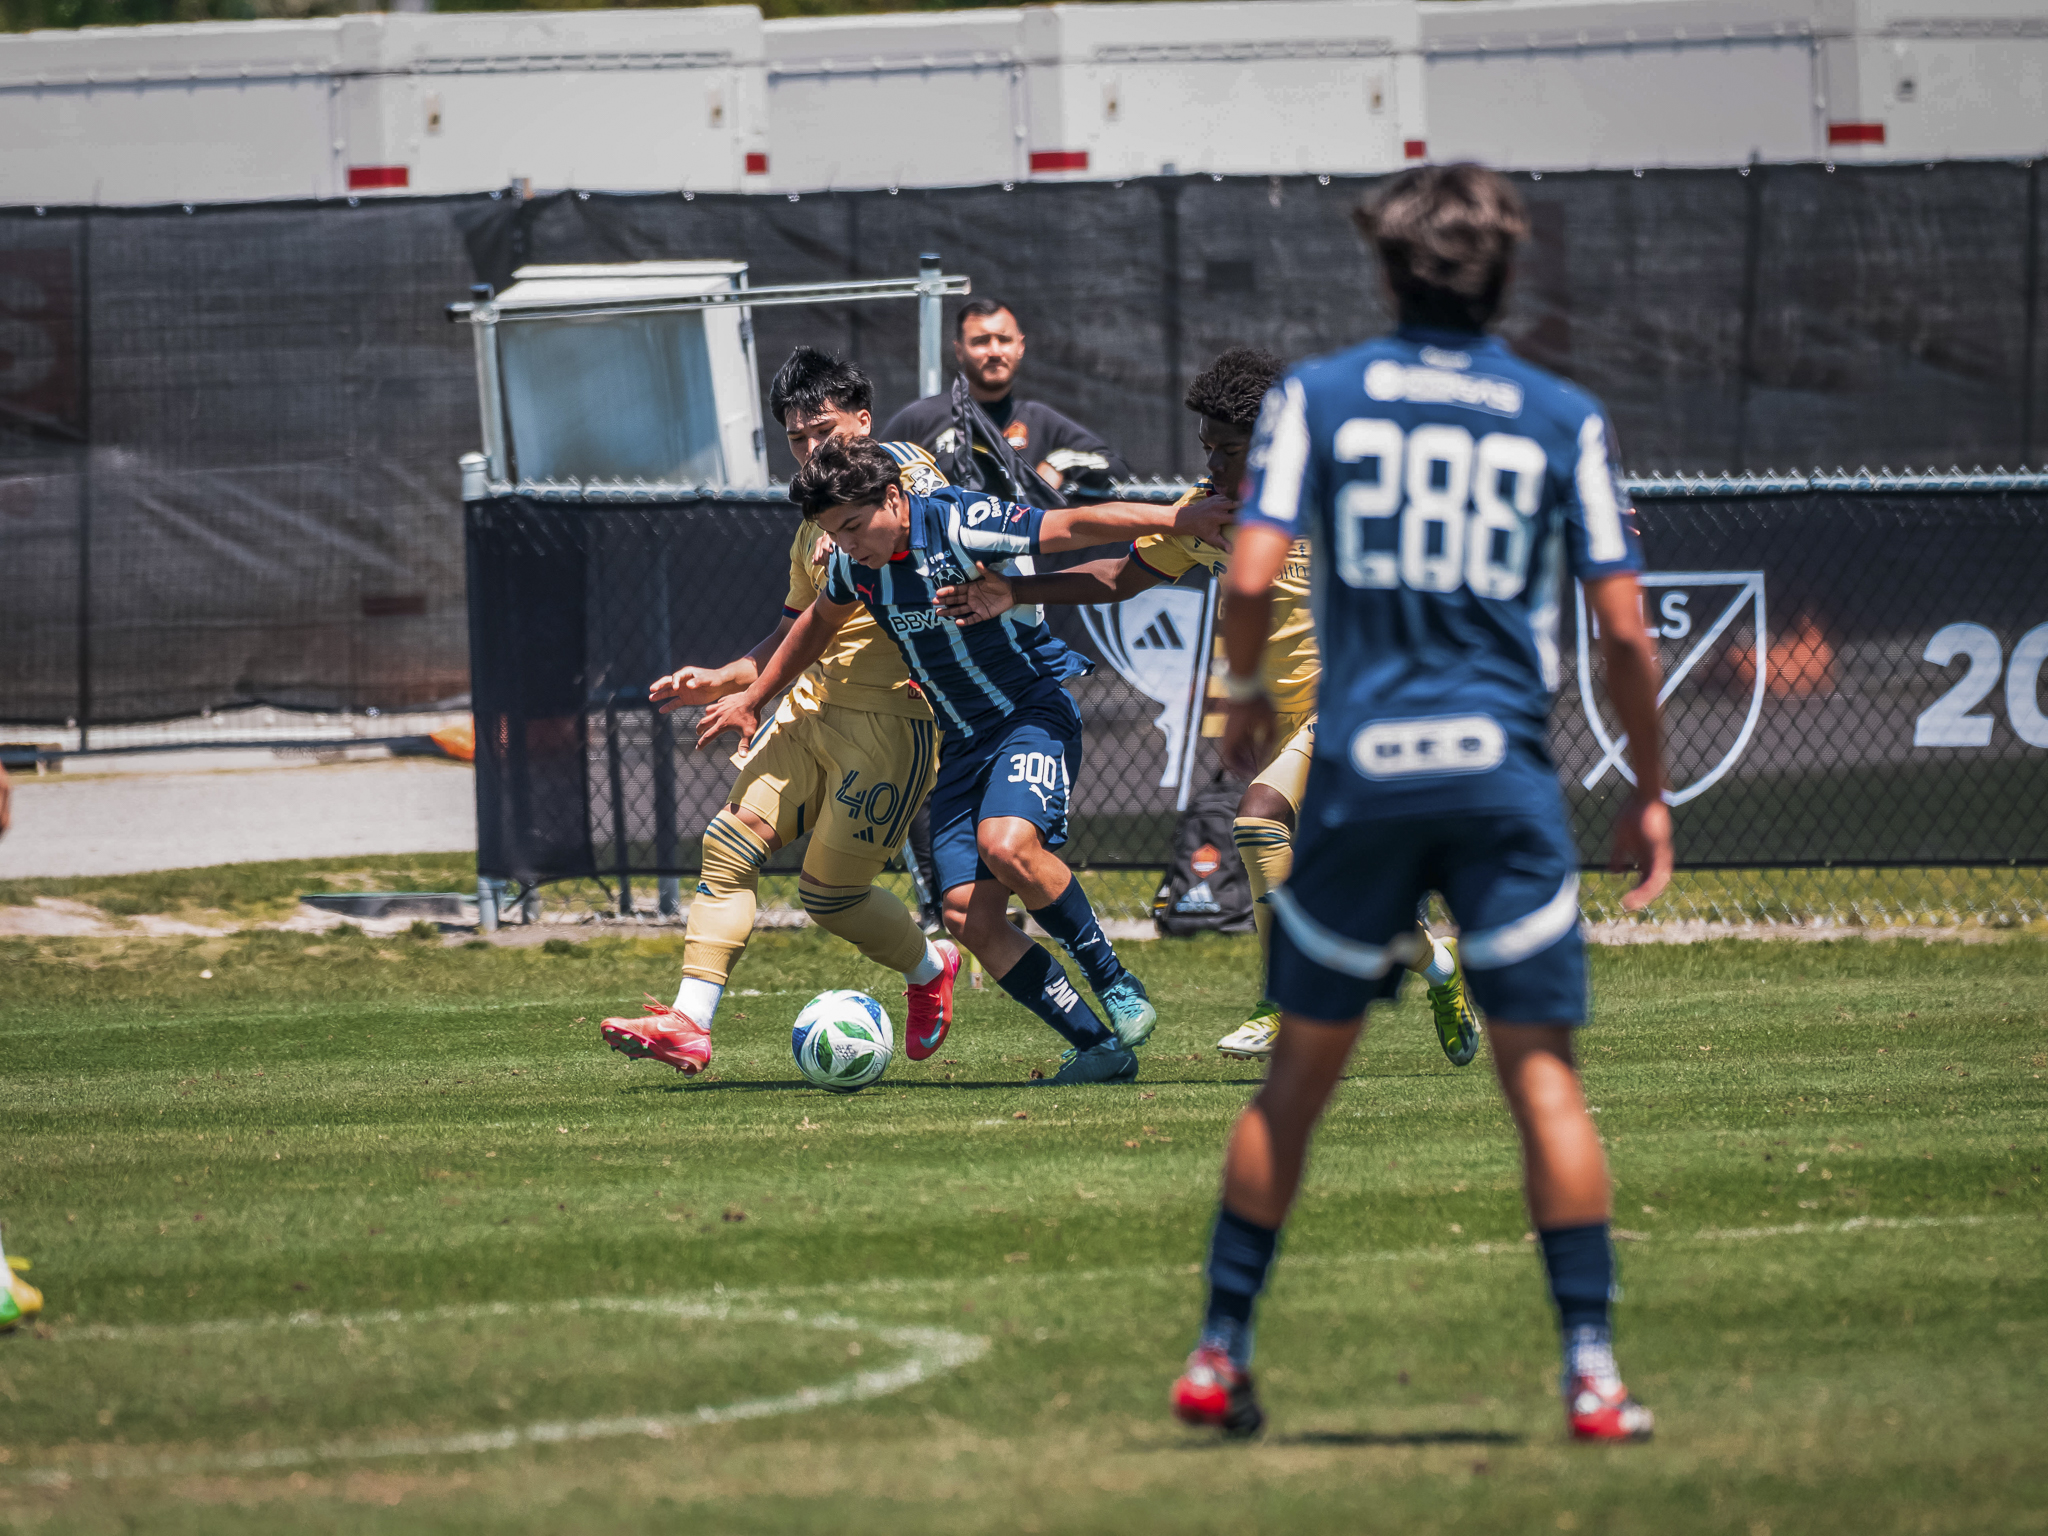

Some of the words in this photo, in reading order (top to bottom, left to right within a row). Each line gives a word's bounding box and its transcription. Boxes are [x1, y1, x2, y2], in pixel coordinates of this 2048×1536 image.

[1334, 417, 1548, 601] 288
[1274, 562, 1307, 581] alth
[1592, 590, 1691, 639] LS
[1008, 752, 1057, 790] 300
[835, 770, 899, 826] 40
